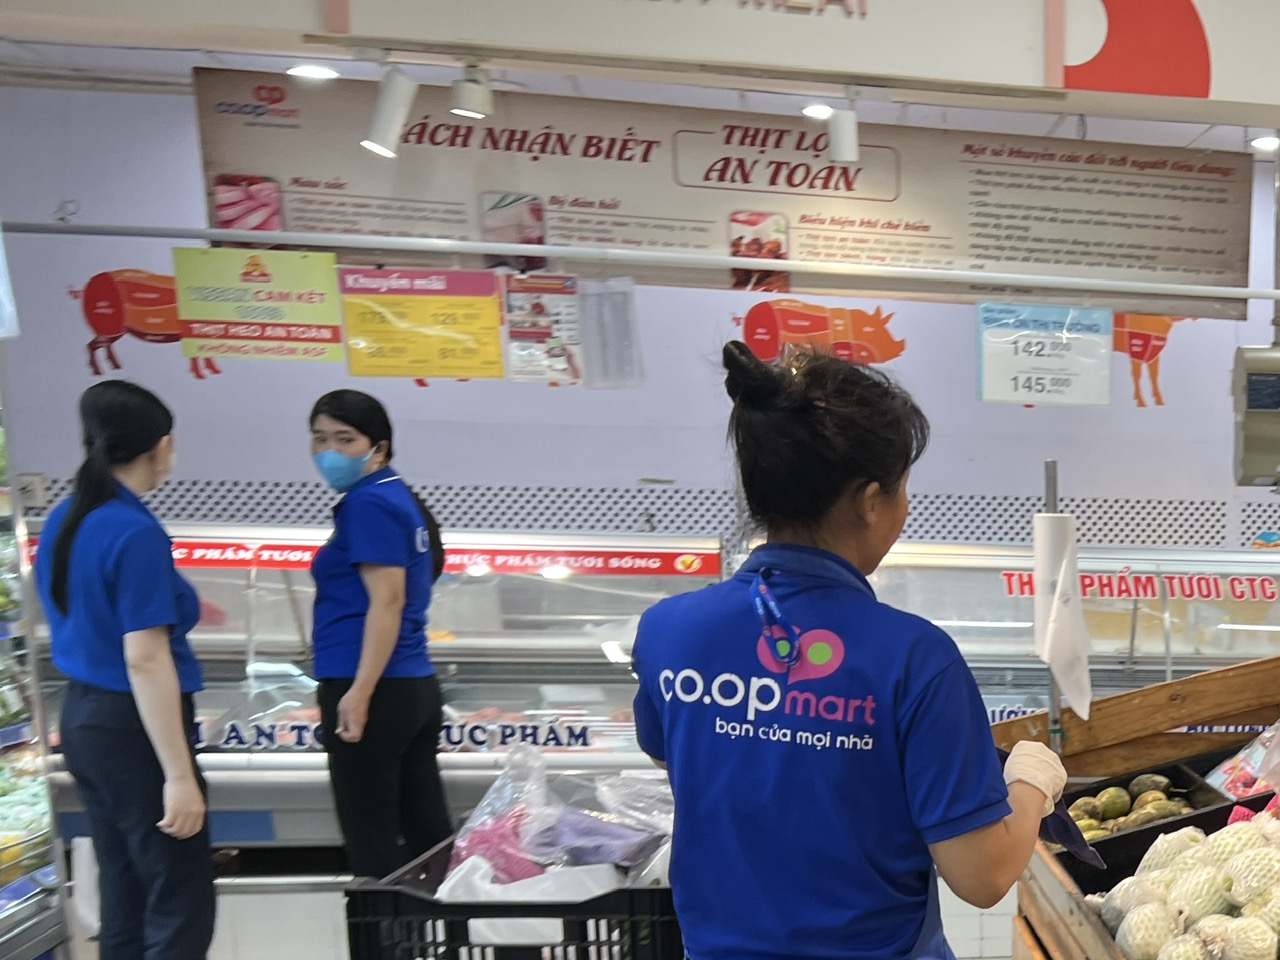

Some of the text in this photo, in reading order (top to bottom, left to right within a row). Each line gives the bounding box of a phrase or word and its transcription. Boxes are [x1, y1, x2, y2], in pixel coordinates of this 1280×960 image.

[402, 114, 661, 164] ÁCH NHẬN BIẾT
[722, 124, 830, 159] THỊT LỌ
[703, 156, 863, 192] AN TOÀN
[190, 546, 254, 561] PHẨM
[446, 554, 491, 568] HỰC
[495, 552, 551, 567] PHẨM
[608, 555, 662, 570] SỐNG
[1002, 565, 1279, 601] TH PHẨM TƯƠI CTC
[223, 722, 279, 747] AN
[500, 717, 592, 747] PHẨM
[715, 716, 754, 740] bạn
[758, 723, 791, 743] của
[796, 731, 831, 751] mọi
